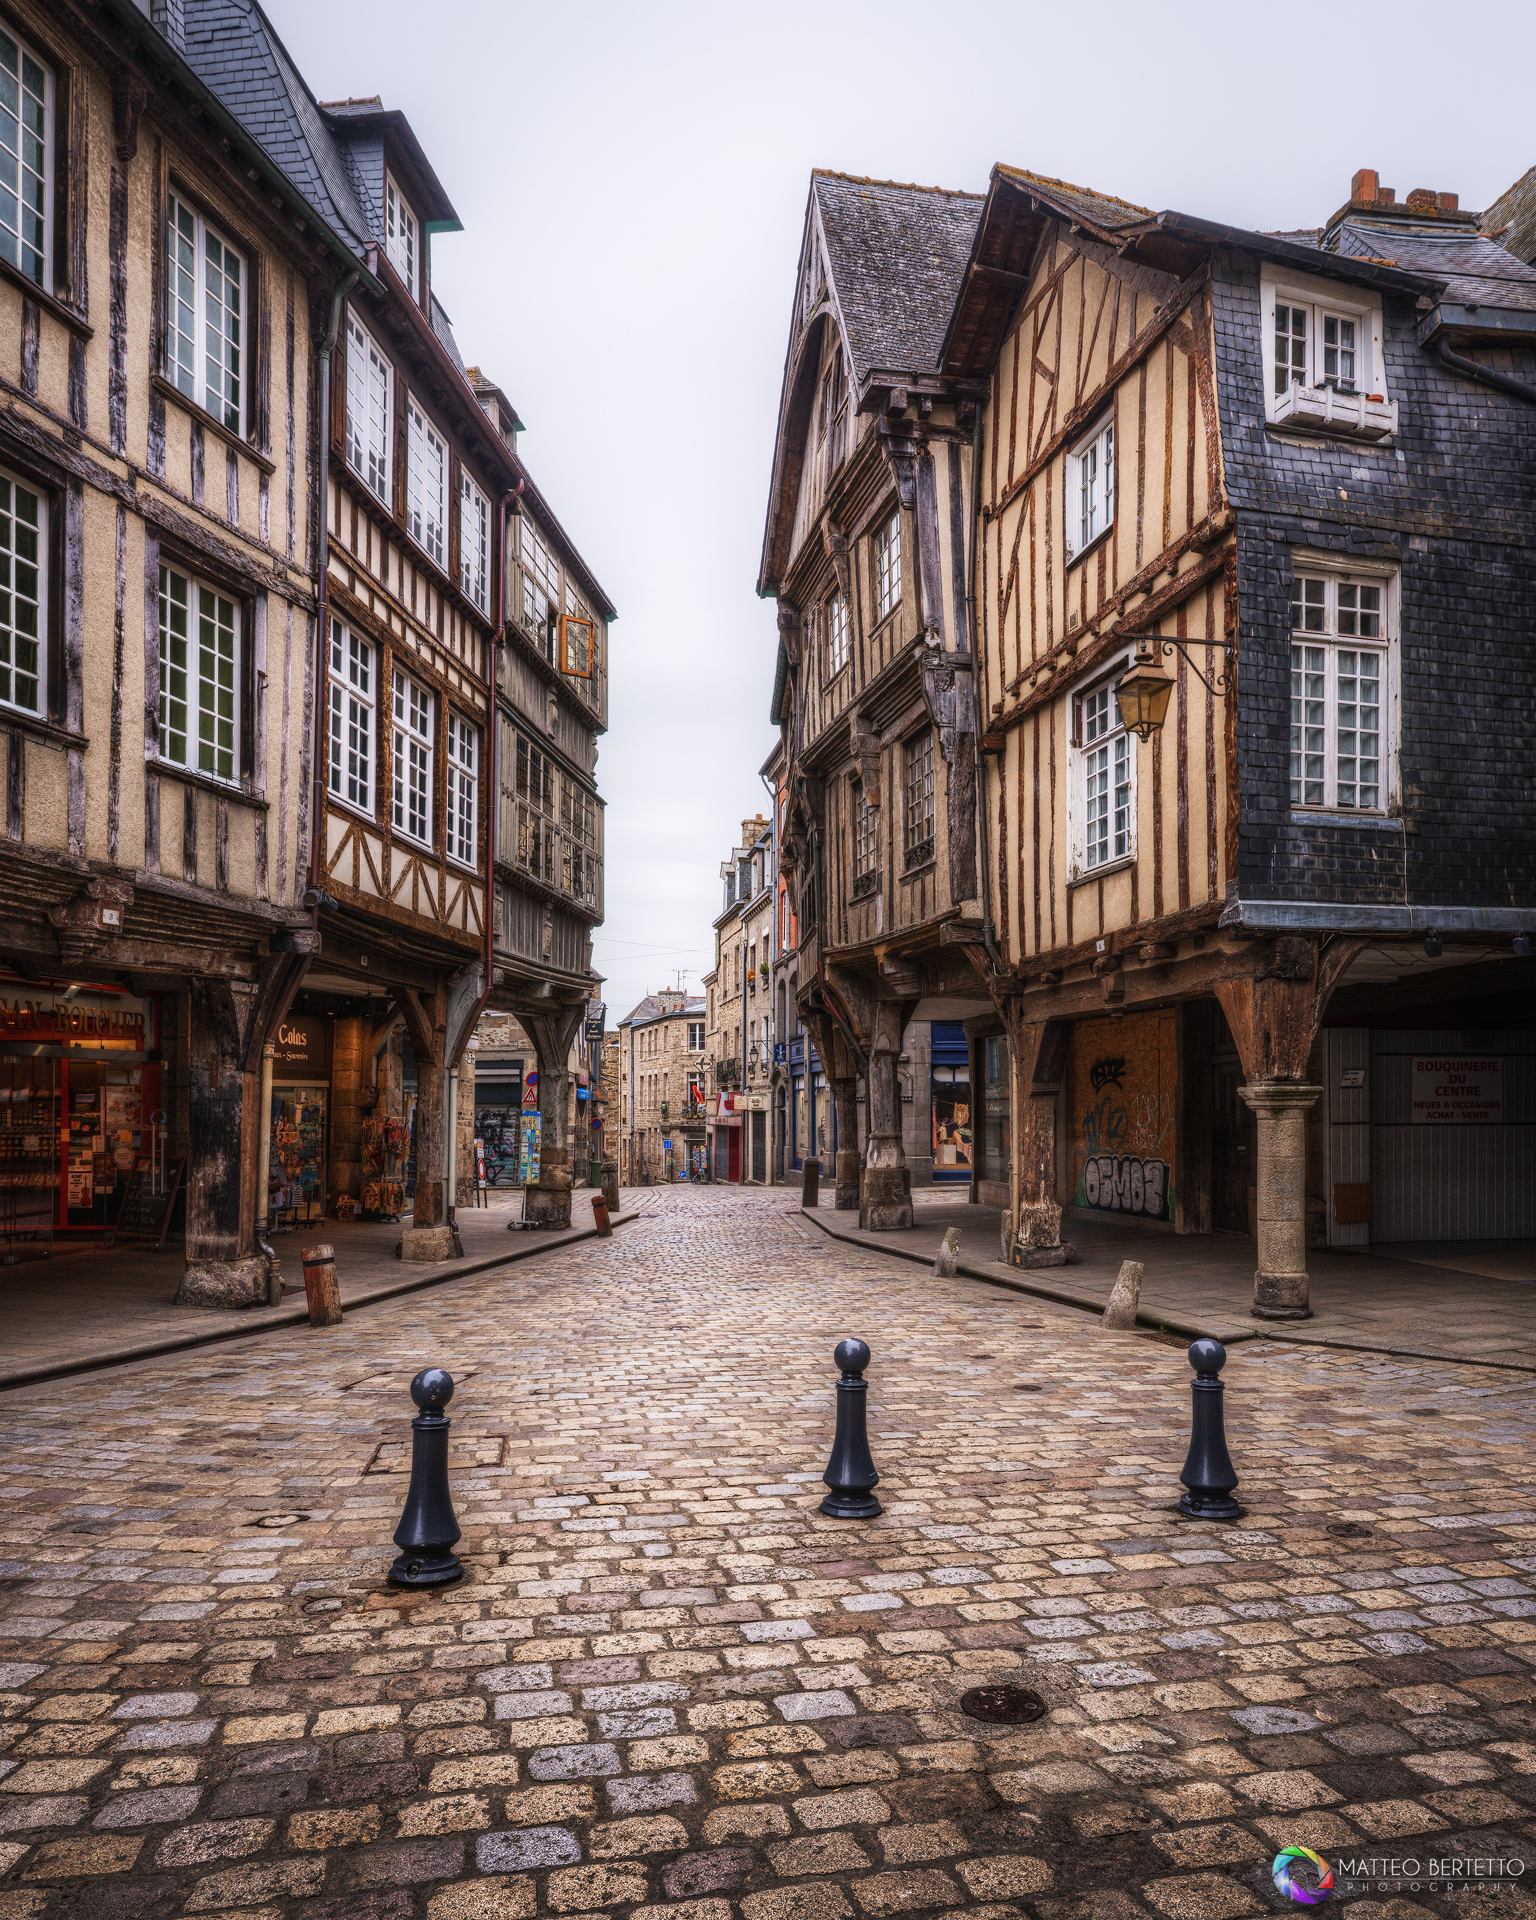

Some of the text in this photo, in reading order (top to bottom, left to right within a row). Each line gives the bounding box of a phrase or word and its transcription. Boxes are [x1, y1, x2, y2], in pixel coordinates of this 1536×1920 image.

[55, 1004, 146, 1039] BOUCHER
[278, 1023, 307, 1046] Colas
[1417, 1061, 1498, 1073] BOUQUINERIE
[1449, 1074, 1466, 1084] DU
[1435, 1086, 1481, 1096] CENTRE
[1414, 1101, 1501, 1109] NEUFS & OCCASIONS
[1426, 1111, 1455, 1119] ACHAT
[1462, 1111, 1489, 1119] VENTE
